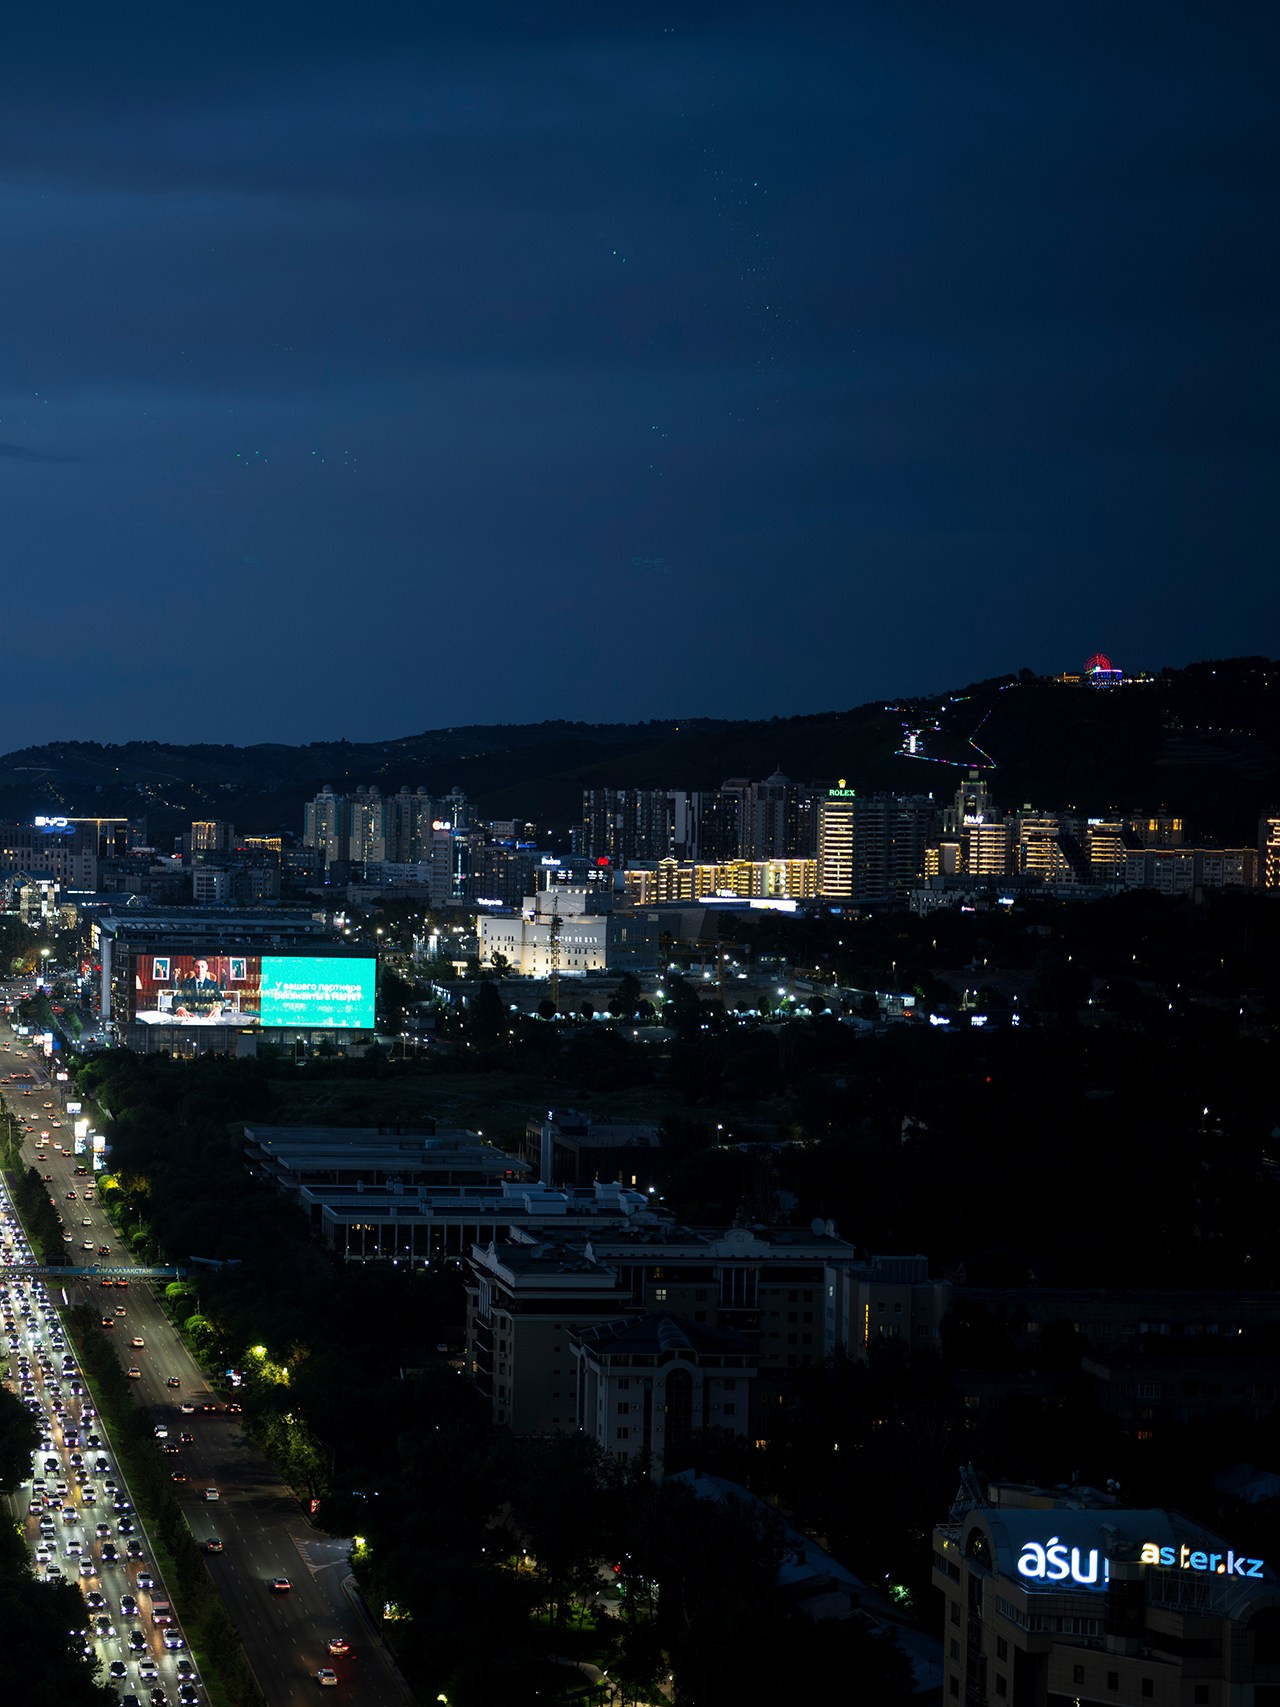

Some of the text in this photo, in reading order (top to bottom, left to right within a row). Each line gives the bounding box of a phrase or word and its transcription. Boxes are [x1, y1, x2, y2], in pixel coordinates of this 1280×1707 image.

[829, 789, 855, 797] ROLEX
[34, 816, 67, 827] BYD
[275, 981, 283, 990] У
[318, 983, 362, 993] партнера
[1140, 1541, 1265, 1579] aster.kz
